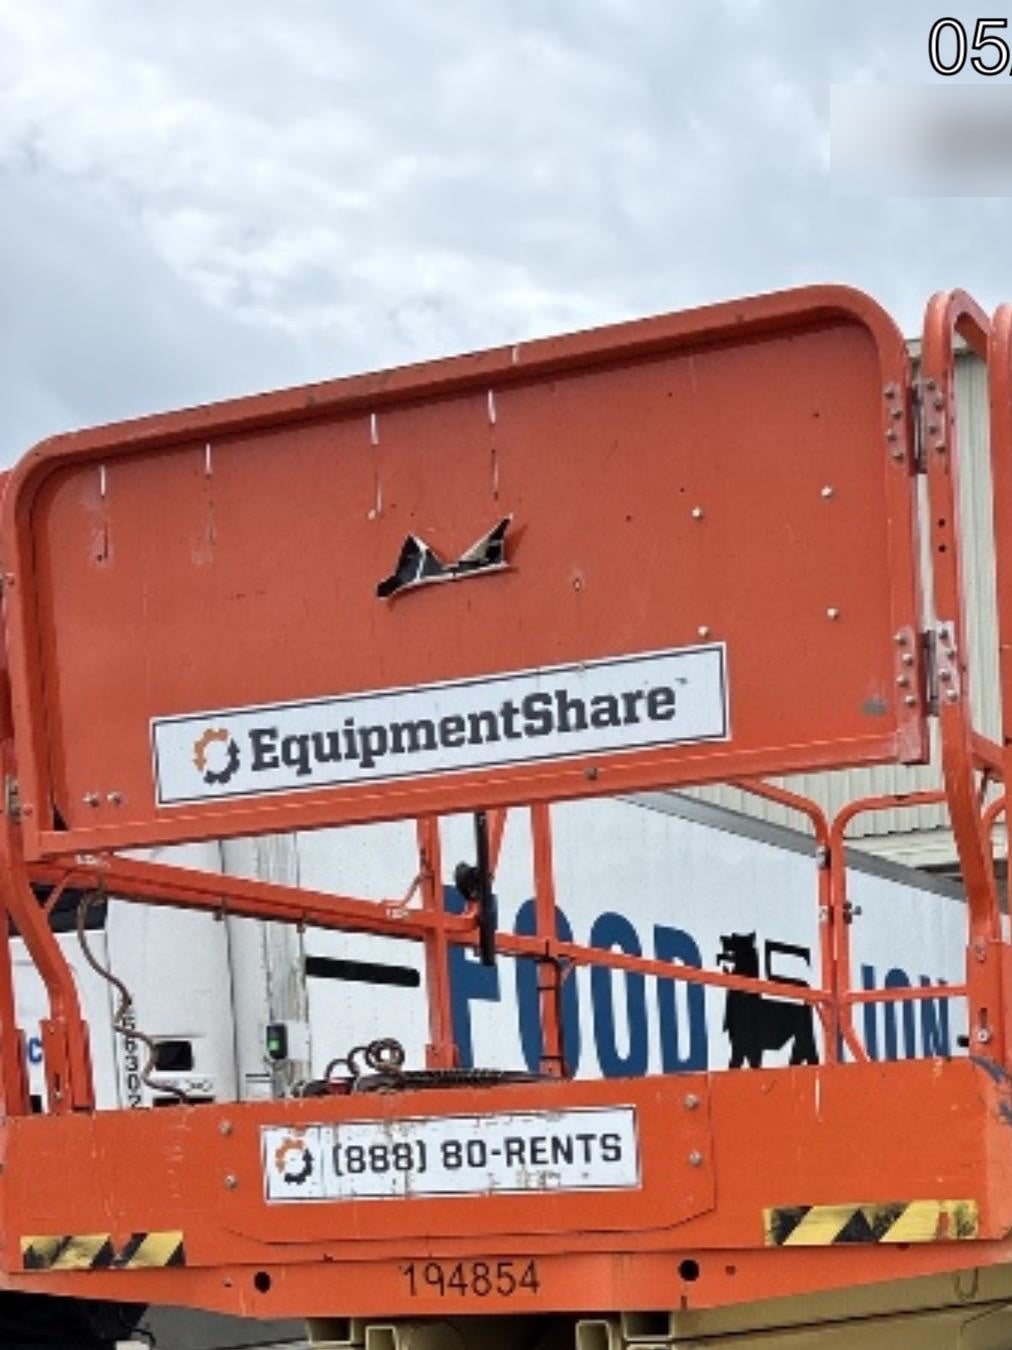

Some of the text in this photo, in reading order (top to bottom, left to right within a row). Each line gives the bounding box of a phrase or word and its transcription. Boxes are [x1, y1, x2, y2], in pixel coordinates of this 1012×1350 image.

[249, 685, 676, 777] EquipmentShare
[331, 1132, 623, 1177] (888) 80-RENTS
[403, 1259, 540, 1297] 194854
